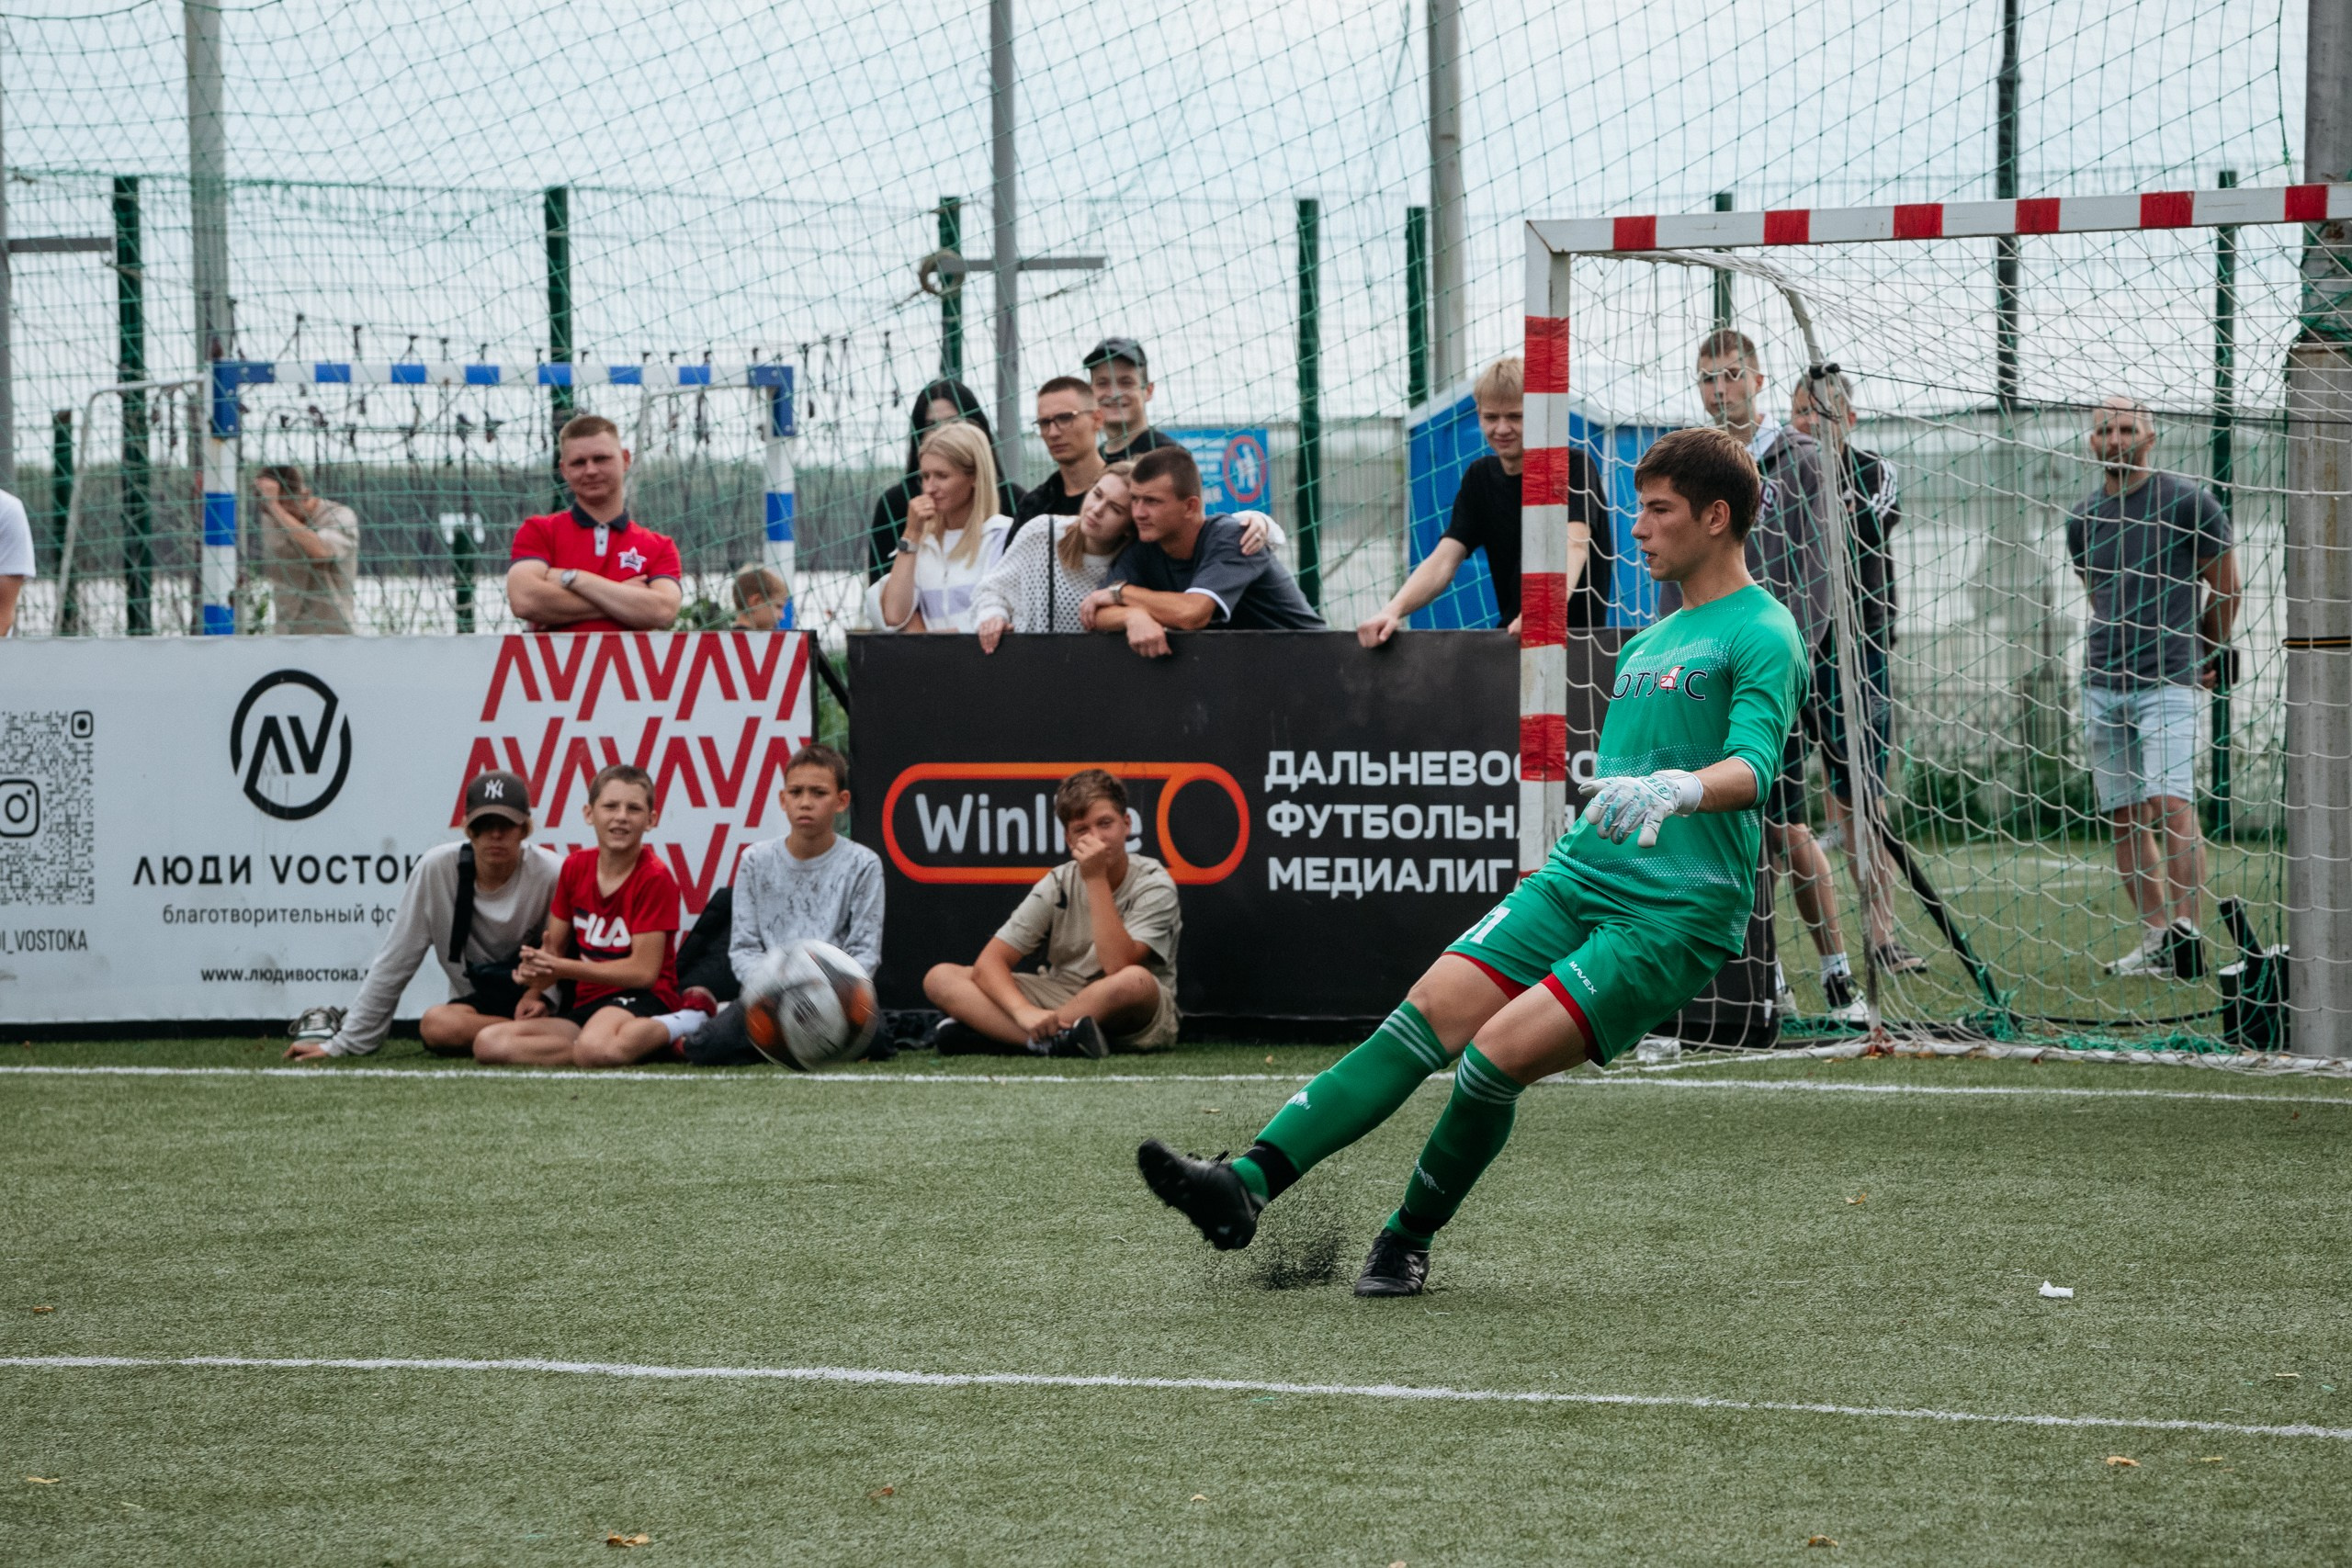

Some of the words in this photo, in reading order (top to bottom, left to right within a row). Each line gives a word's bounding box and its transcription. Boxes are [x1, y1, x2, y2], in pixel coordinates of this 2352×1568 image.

[1264, 750, 1598, 792] ДАЛЬНЕВОО
[1266, 800, 1576, 840] ФУТБОЛЬН
[163, 903, 365, 927] благотворительный
[0, 930, 88, 954] I_VOSTOKA
[1569, 961, 1598, 995] MAVEX
